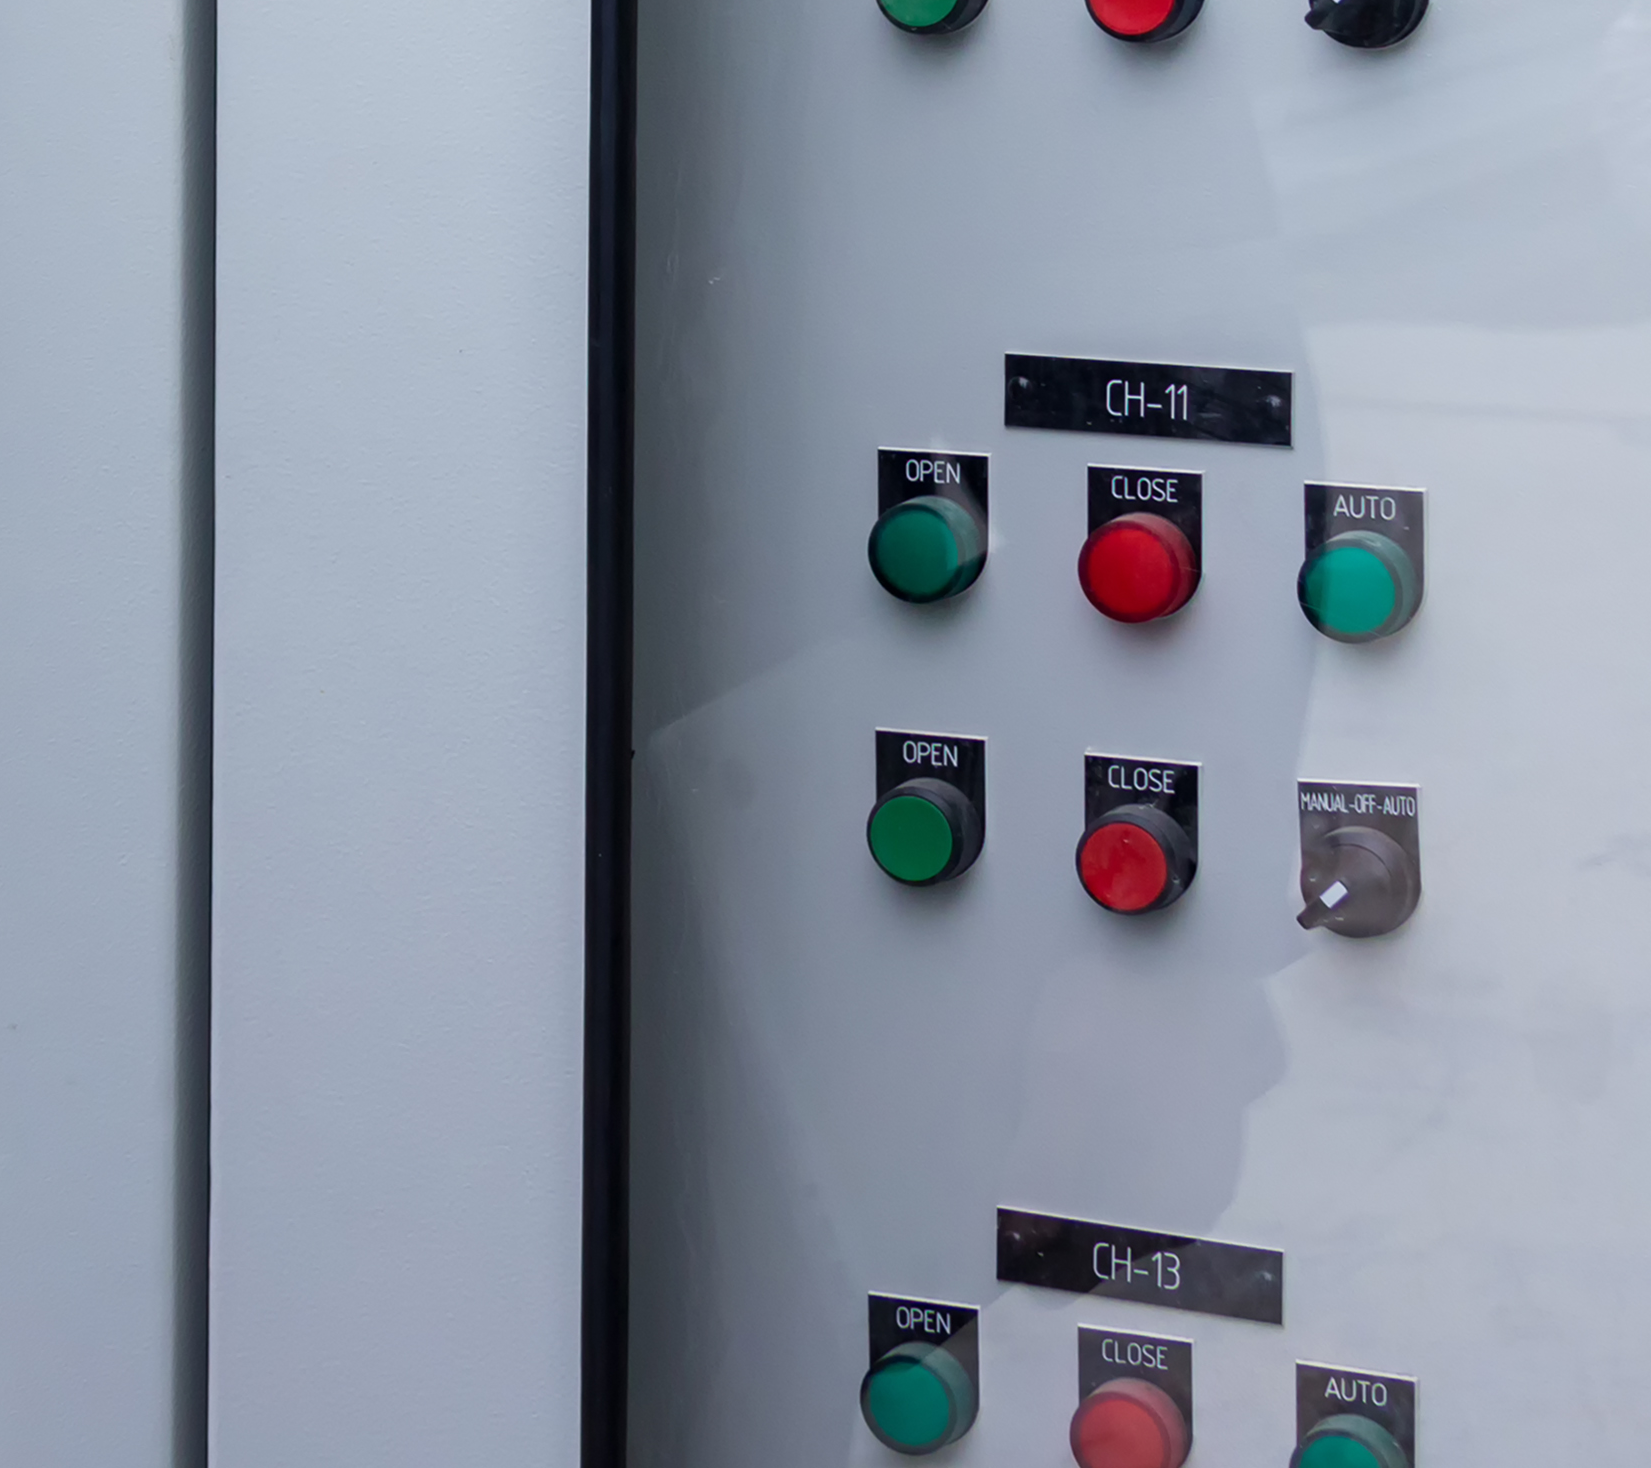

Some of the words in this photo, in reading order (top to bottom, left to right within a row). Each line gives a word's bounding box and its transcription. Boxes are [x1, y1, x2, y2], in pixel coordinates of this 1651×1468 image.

[1106, 379, 1188, 421] CH-11
[905, 458, 961, 484] OPEN
[1111, 475, 1179, 503] CLOSE
[1332, 494, 1396, 521] AUTO
[902, 740, 958, 768] OPEN
[1107, 764, 1176, 794] CLOSE
[1300, 791, 1416, 817] MANUAL-OFF-AUTO
[1092, 1242, 1181, 1290] CH-13
[895, 1305, 951, 1335] OPEN
[1101, 1338, 1169, 1371] CLOSE
[1324, 1376, 1388, 1407] AUTO
